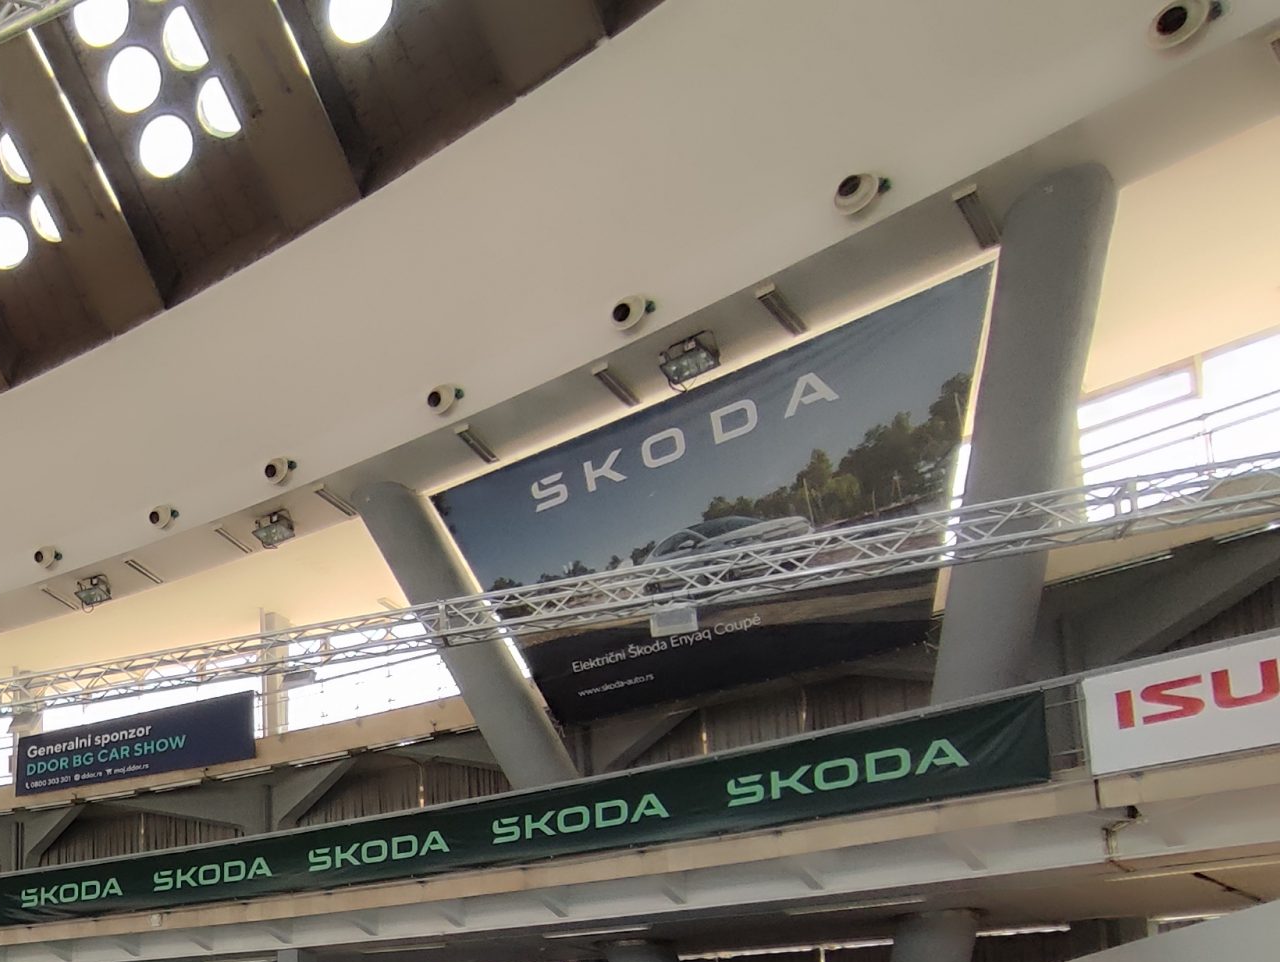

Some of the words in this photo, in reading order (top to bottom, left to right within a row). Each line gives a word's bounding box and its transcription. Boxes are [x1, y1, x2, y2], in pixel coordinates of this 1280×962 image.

[627, 639, 668, 660] Škoda
[670, 628, 713, 647] Enyaq
[714, 613, 761, 635] Coupé
[577, 672, 655, 697] www.skoda-auto.rs
[1115, 659, 1280, 729] ISU
[26, 756, 69, 776] DDOR
[72, 752, 94, 768] BG
[97, 745, 131, 763] CAR
[133, 734, 187, 757] SHOW
[27, 734, 92, 758] Generalni
[94, 724, 152, 748] sponzor
[30, 780, 47, 788] 0800
